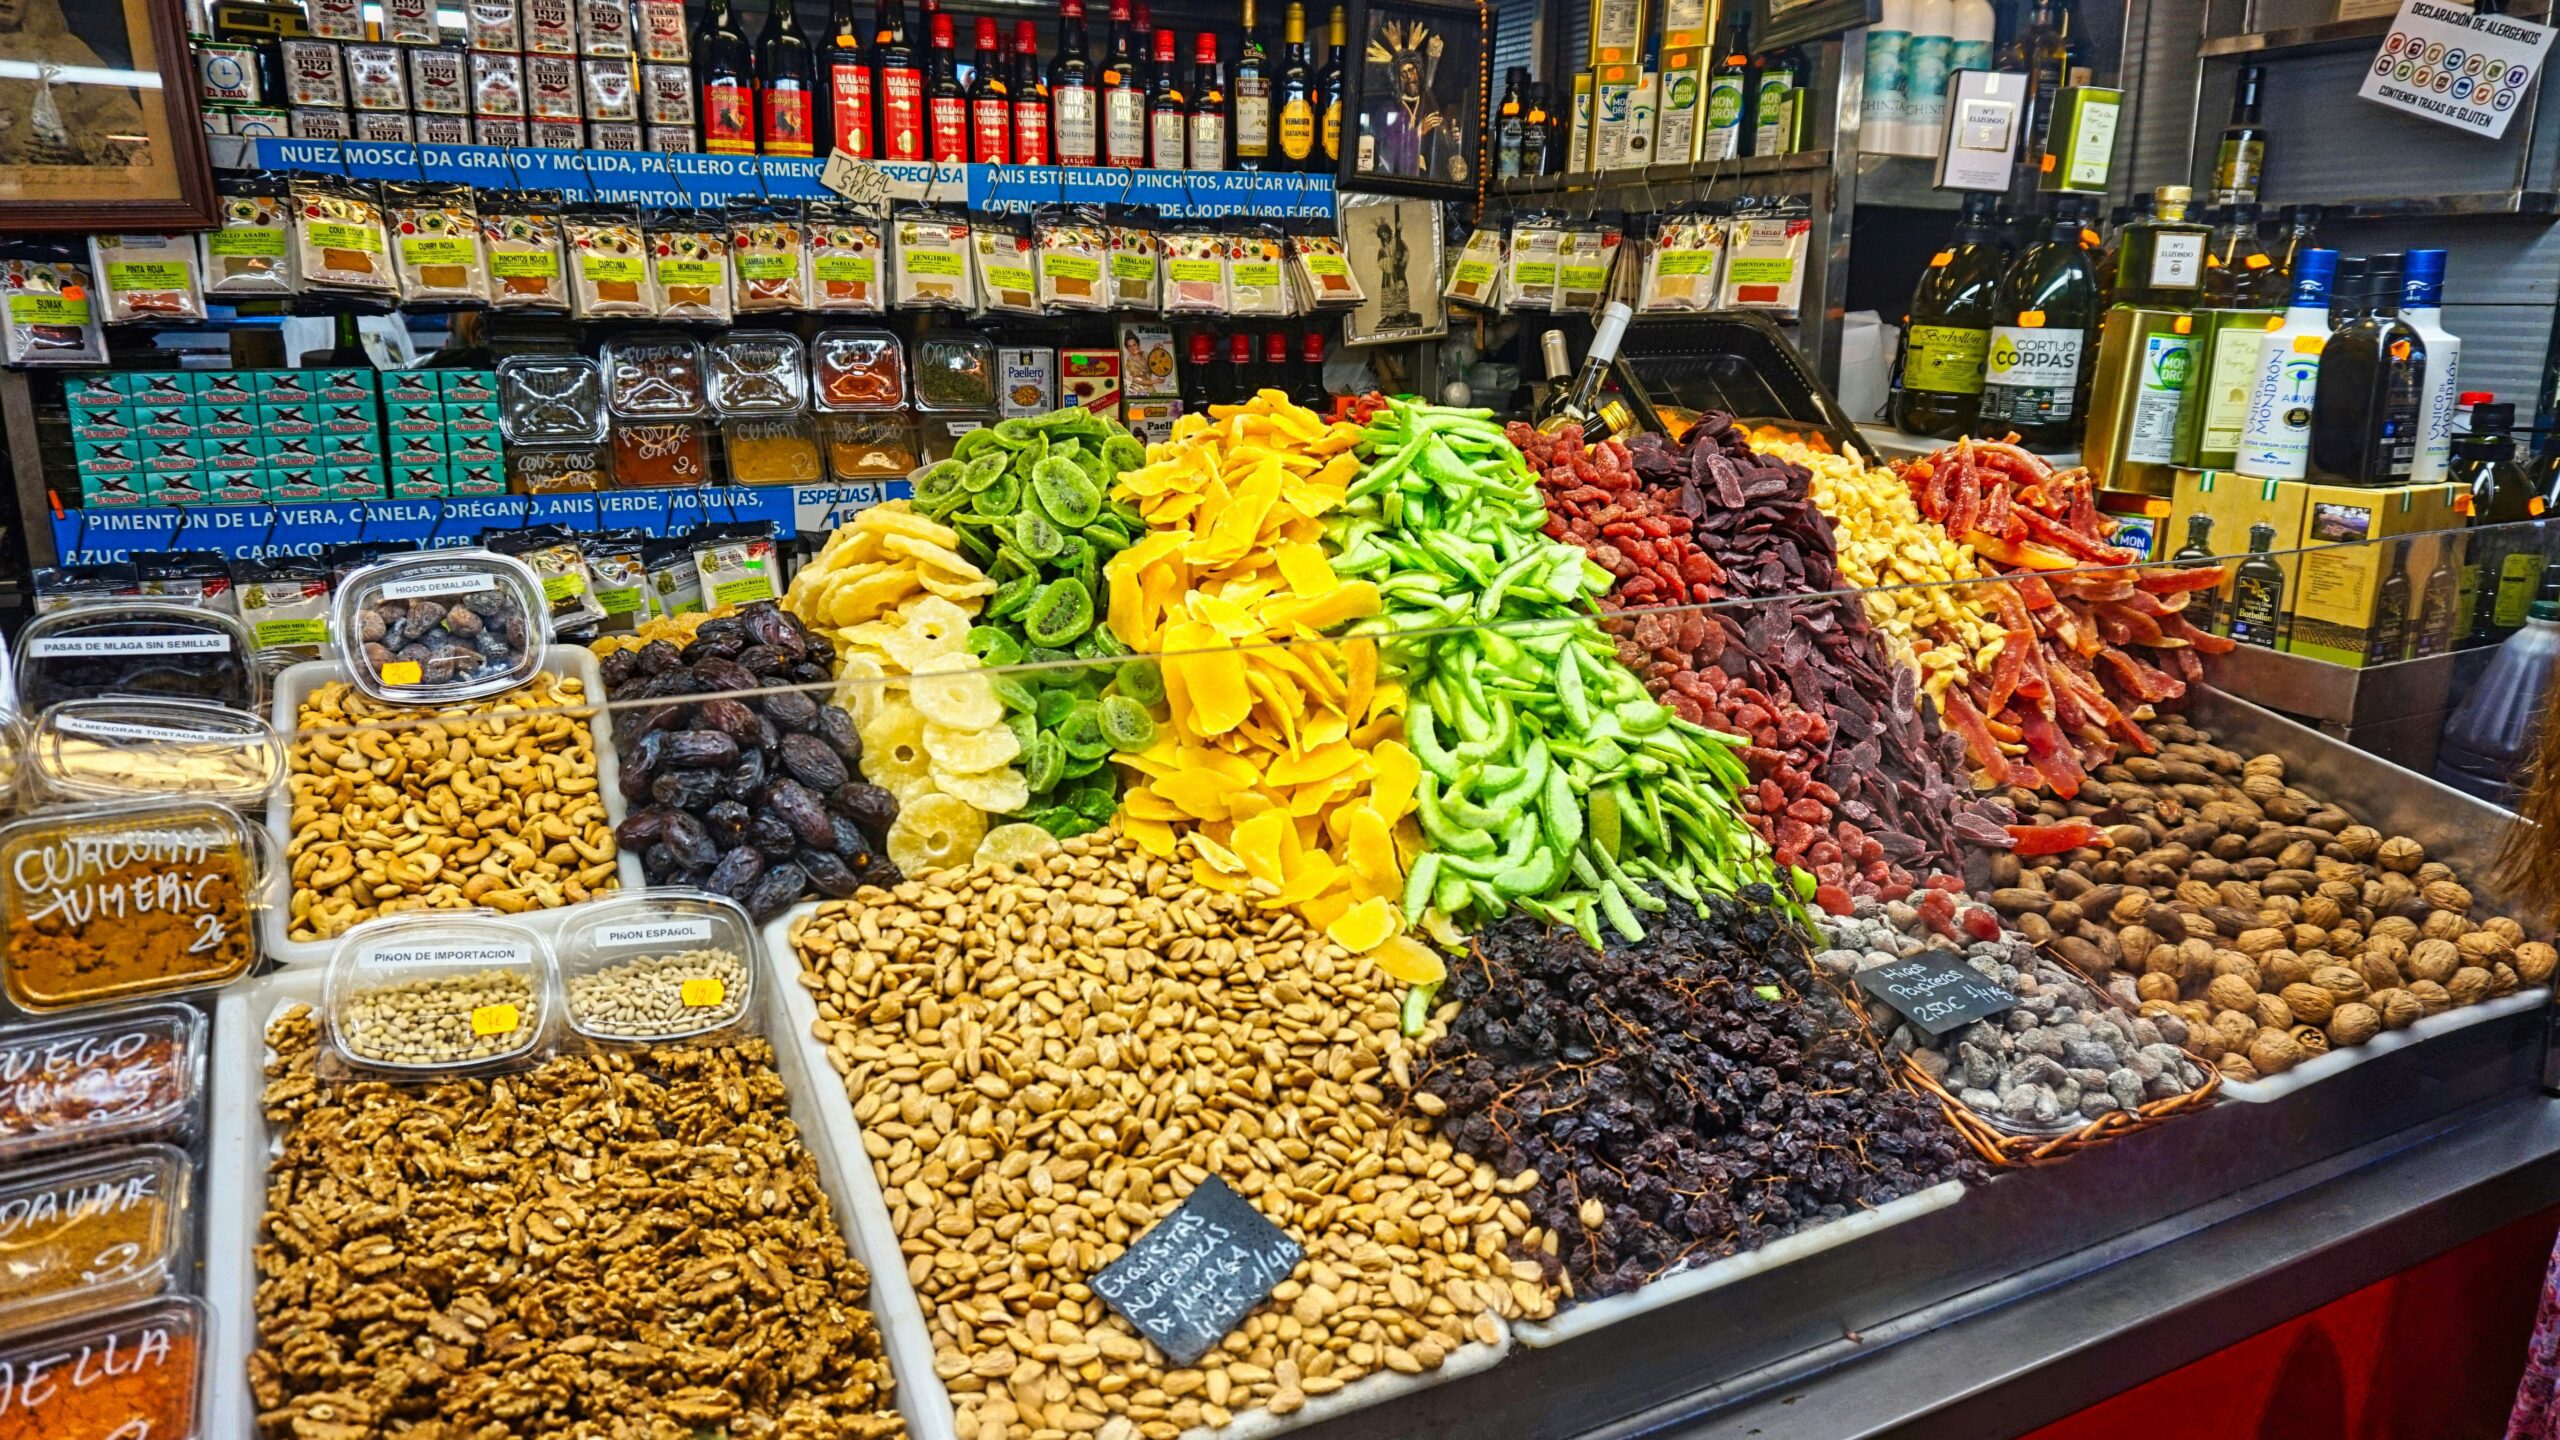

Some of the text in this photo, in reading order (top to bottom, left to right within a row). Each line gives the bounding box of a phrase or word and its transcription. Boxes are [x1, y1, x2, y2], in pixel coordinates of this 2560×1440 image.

[534, 9, 565, 21] 1921
[589, 11, 622, 23] 1921
[650, 17, 679, 28] 1921
[2411, 2, 2542, 45] DECLARACIÓN DE ALERGENOS
[297, 60, 333, 71] 1921
[423, 68, 456, 79] 1921
[536, 74, 568, 85] 1921
[206, 87, 248, 98] EL RELOJ
[1675, 85, 1693, 95] MON
[1674, 93, 1695, 103] DRON
[1712, 97, 1735, 108] MON
[1761, 94, 1782, 105] MON
[2378, 85, 2493, 127] CONTIENEN TRAZAS DE GLUTEN
[1710, 108, 1740, 119] DRON
[1969, 116, 2005, 124] ELIZONDO
[305, 128, 339, 138] 1921
[487, 136, 518, 147] 1921
[603, 140, 634, 150] 1921
[281, 146, 734, 175] NUEZ MOSCADA GRANO Y MOLIDA, PAELLERO
[833, 154, 894, 193] TYPICAL
[880, 166, 963, 183] ESPECIAS A
[987, 169, 1283, 191] ANIS PINCHITOS, AZUCAR
[1214, 205, 1231, 218] DE
[329, 226, 365, 237] COUS COUS
[417, 241, 455, 250] CURRY INDIA
[498, 255, 548, 263] PINCHITOS ROJOS
[913, 254, 953, 262] JENGIBRE
[2161, 250, 2193, 258] ELIZONDO
[598, 261, 627, 271] CURCUMA
[678, 262, 704, 271] MORUNAS
[1120, 257, 1151, 266] ENSALADA
[126, 265, 164, 274] PINTA ROJA
[37, 299, 63, 310] SUMAK
[1138, 325, 1169, 334] Paella
[2016, 339, 2076, 352] CORTIJO
[1996, 351, 2075, 368] CORPAS
[1008, 366, 1044, 378] Paellero
[2257, 349, 2285, 434] MONDRÓN
[2441, 352, 2458, 438] MONDRÓN
[798, 486, 881, 505] ESPECIAS A
[89, 492, 763, 531] PIMENTON DE LA VERA, CANELA, ORÉGANO, ANIS VERDE, MORUNAS,
[2120, 535, 2146, 548] MON
[395, 585, 426, 595] HIGOS
[716, 583, 745, 593] PIMIENTA
[2239, 608, 2272, 622] Borbollón
[262, 623, 290, 631] COMINO
[43, 644, 82, 652] PASAS
[104, 641, 143, 650] MLAGA
[146, 641, 164, 649] SIN
[166, 639, 221, 649] SEMILLAS
[71, 722, 142, 735] ALMENDRAS
[146, 728, 205, 741] TOSTADAS
[416, 951, 432, 961] DE
[434, 949, 515, 960] IMPORTACION
[1879, 963, 1928, 982] Higos
[1888, 970, 1964, 1000] Pajareros
[1913, 996, 1966, 1023] 2,50€
[1096, 1210, 1205, 1298] EXQUISITAS
[1123, 1223, 1237, 1319] ALMENDRAS
[1173, 1244, 1250, 1322] MALAGA
